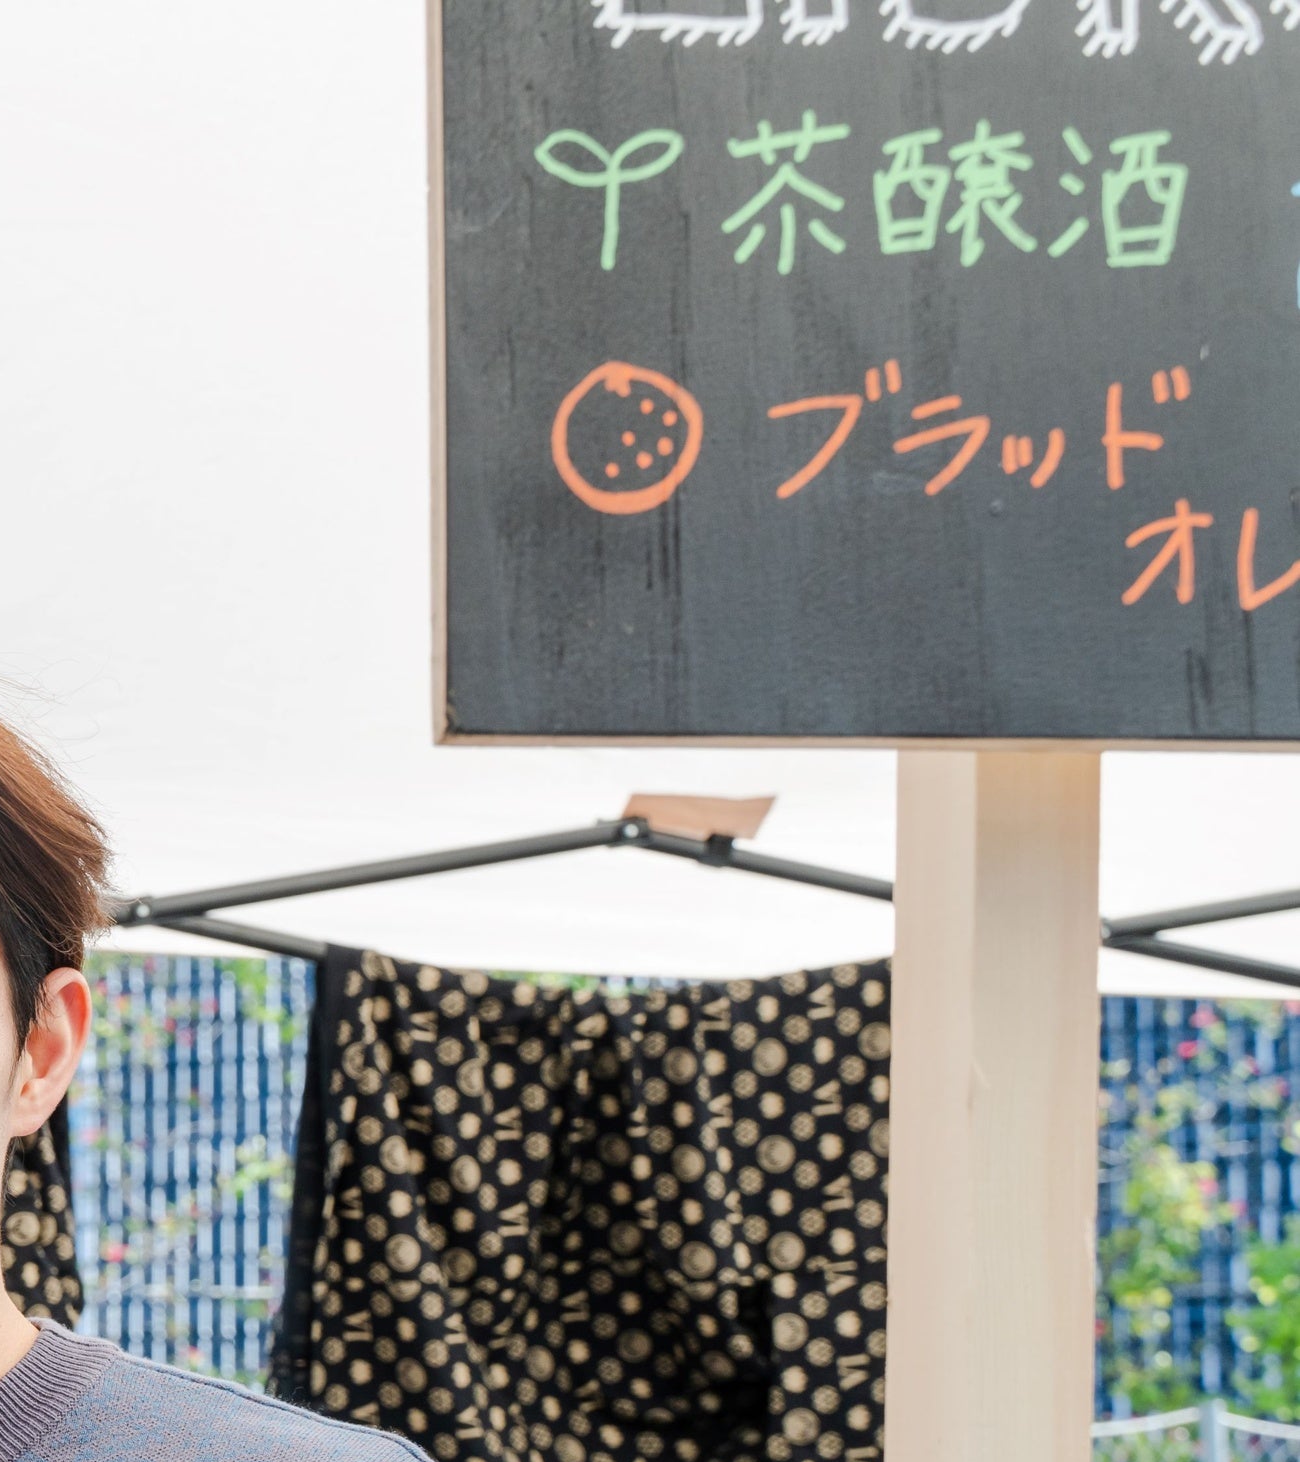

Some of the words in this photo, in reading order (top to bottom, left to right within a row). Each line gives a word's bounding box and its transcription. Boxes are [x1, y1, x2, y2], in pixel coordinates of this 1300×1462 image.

[722, 109, 1188, 275] 茶醸酒
[768, 360, 1190, 497] ブラッド
